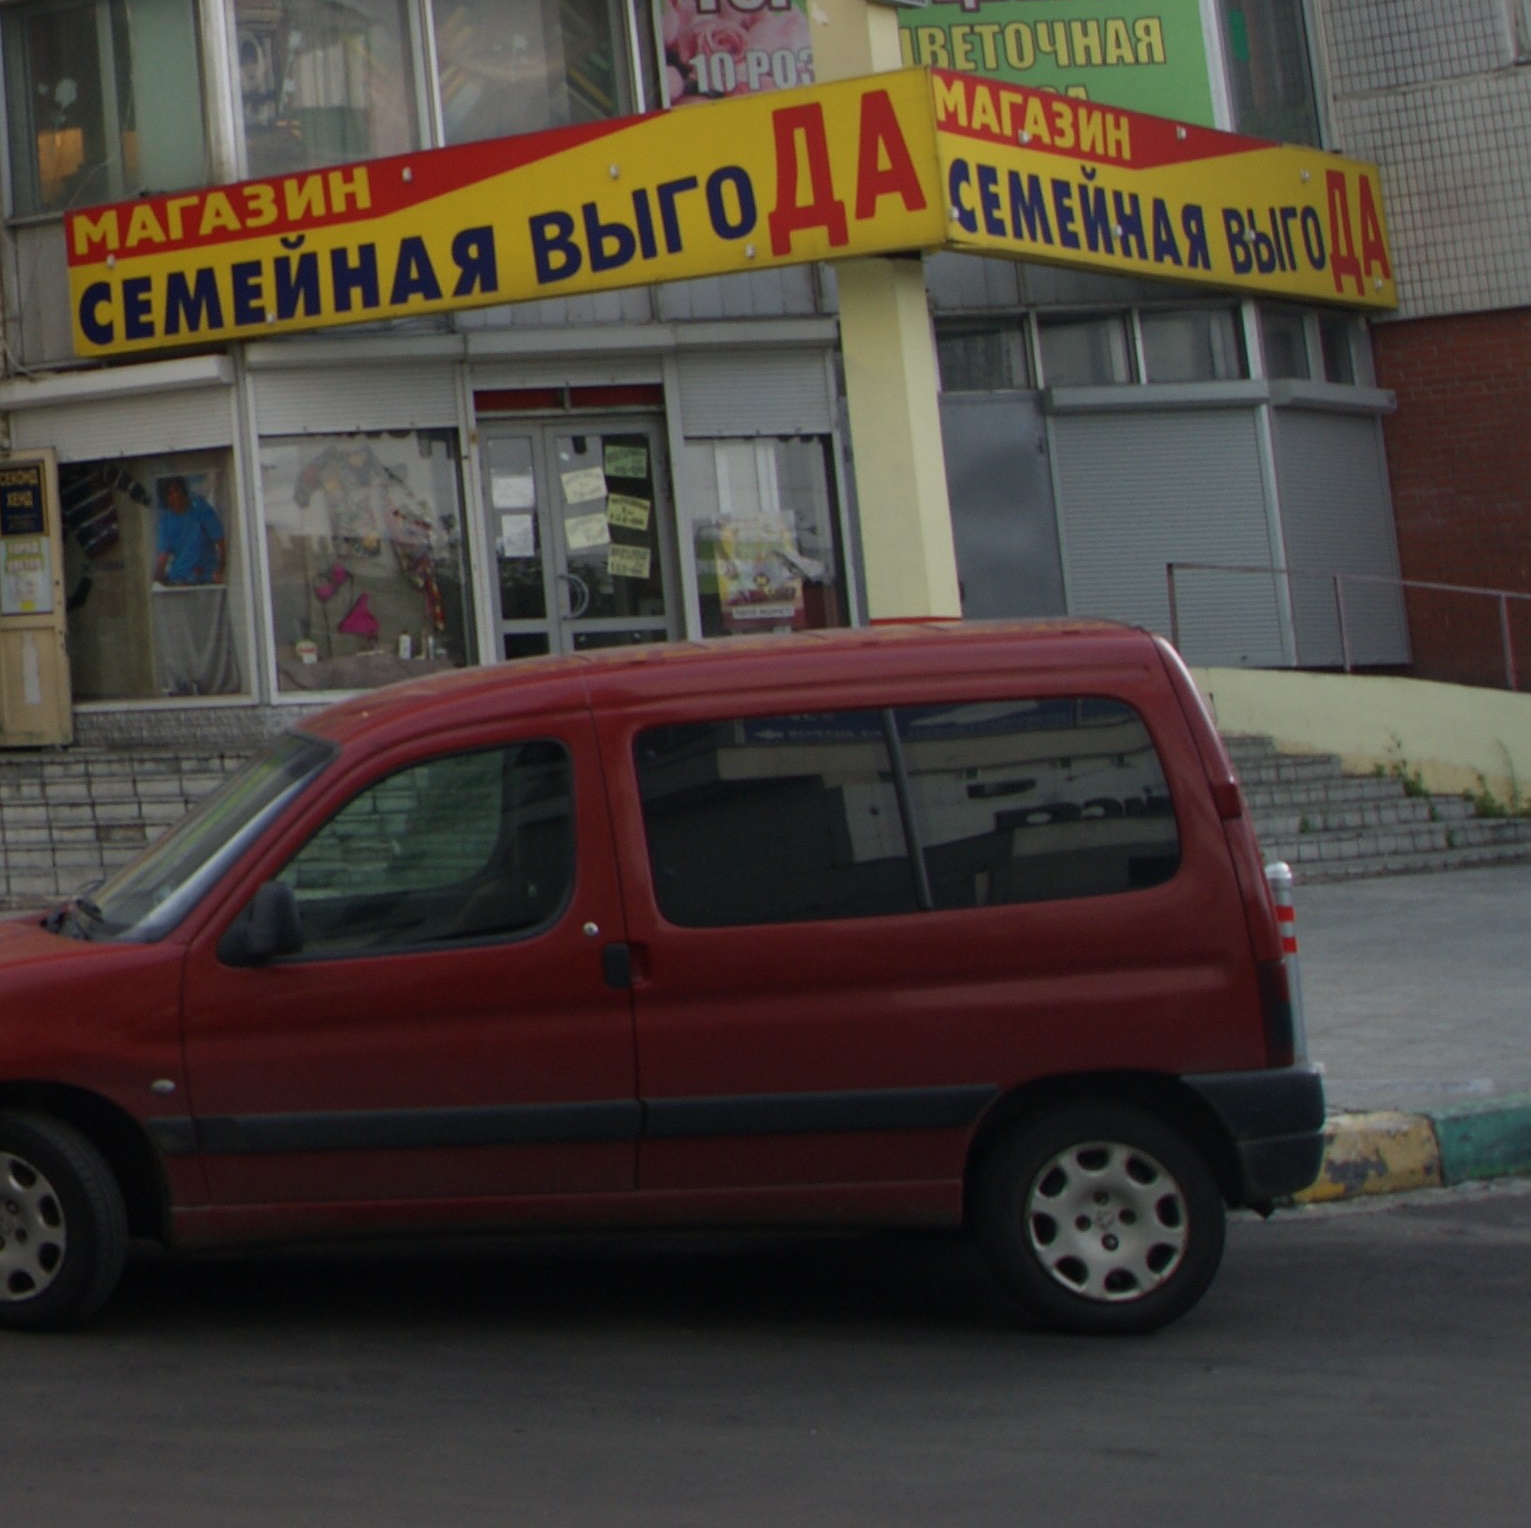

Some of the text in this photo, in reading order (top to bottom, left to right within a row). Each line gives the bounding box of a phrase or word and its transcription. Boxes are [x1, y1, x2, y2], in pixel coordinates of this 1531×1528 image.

[689, 51, 736, 93] 10
[931, 74, 1131, 161] МАГАЗИН
[72, 166, 372, 256] МАГАЗИН
[79, 89, 927, 346] СЕМЕЙНАЯ ВЫГОДА
[948, 158, 1391, 297] СЕМЕЙНАЯ ВЫГОДА
